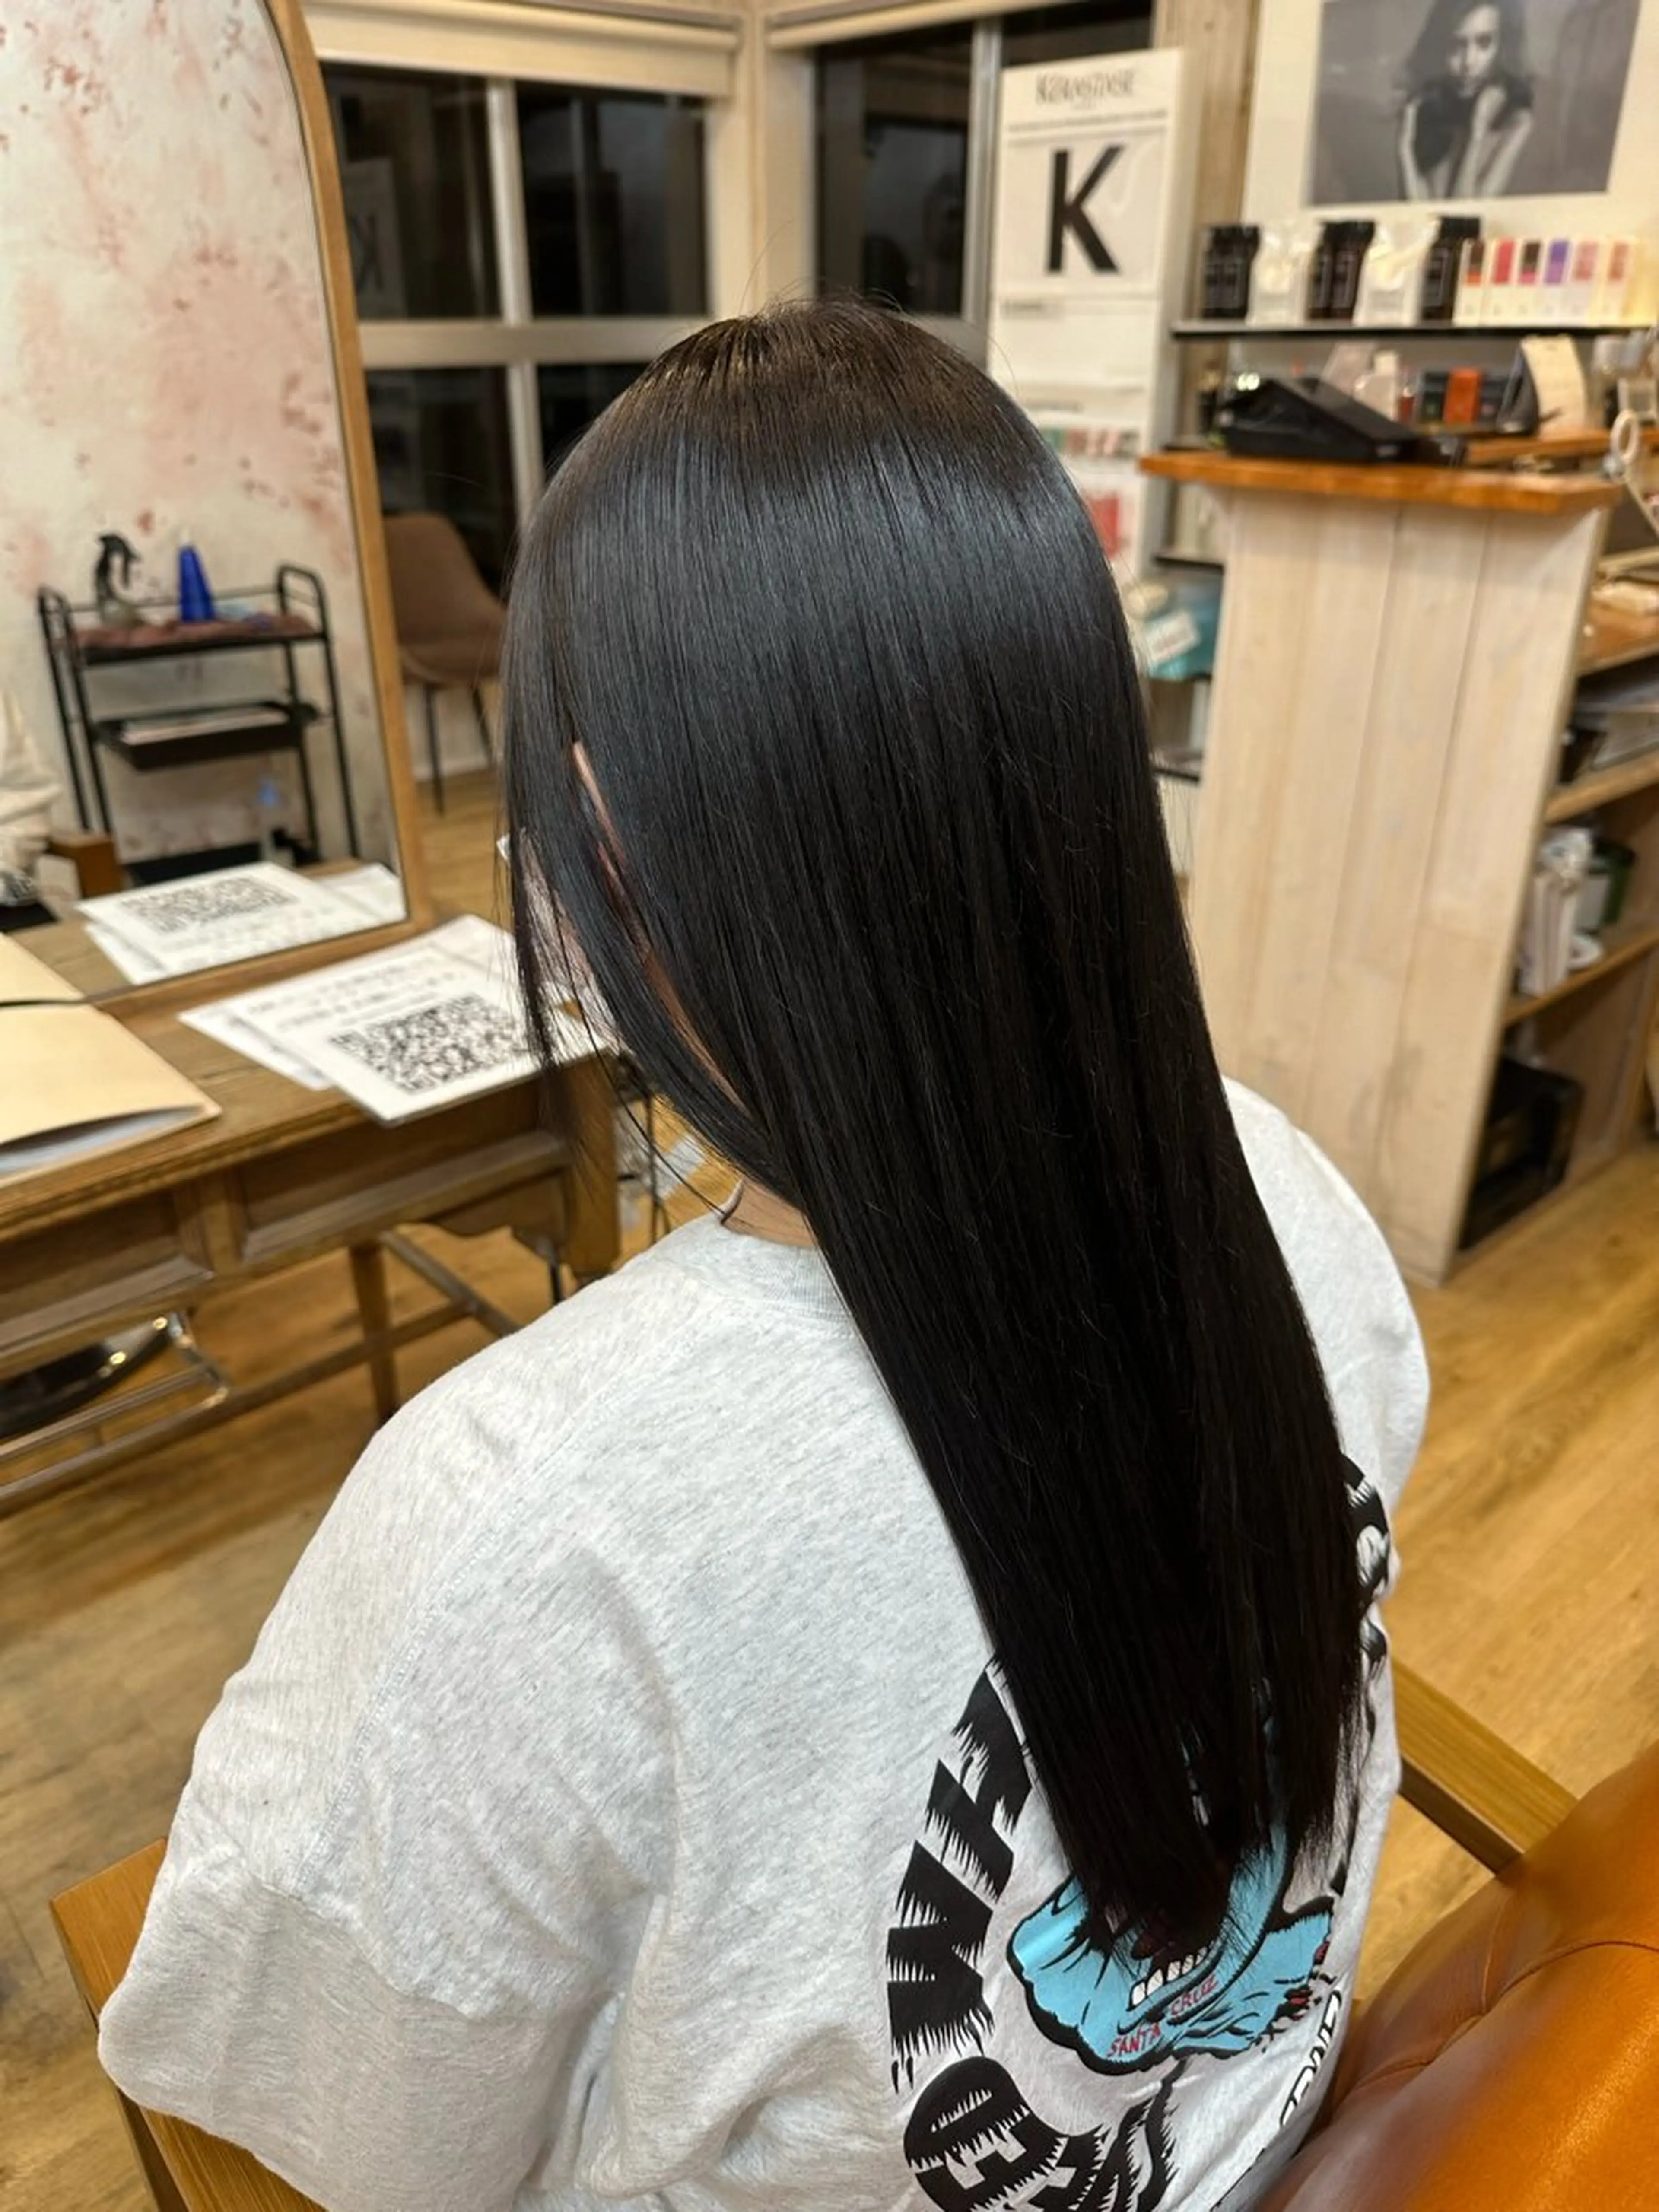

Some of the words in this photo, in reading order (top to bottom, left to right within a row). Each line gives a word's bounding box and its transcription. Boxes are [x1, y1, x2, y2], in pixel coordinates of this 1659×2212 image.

[1046, 143, 1124, 276] K
[1106, 2023, 1161, 2057] SANTA
[1170, 1973, 1219, 2015] CRUZ
